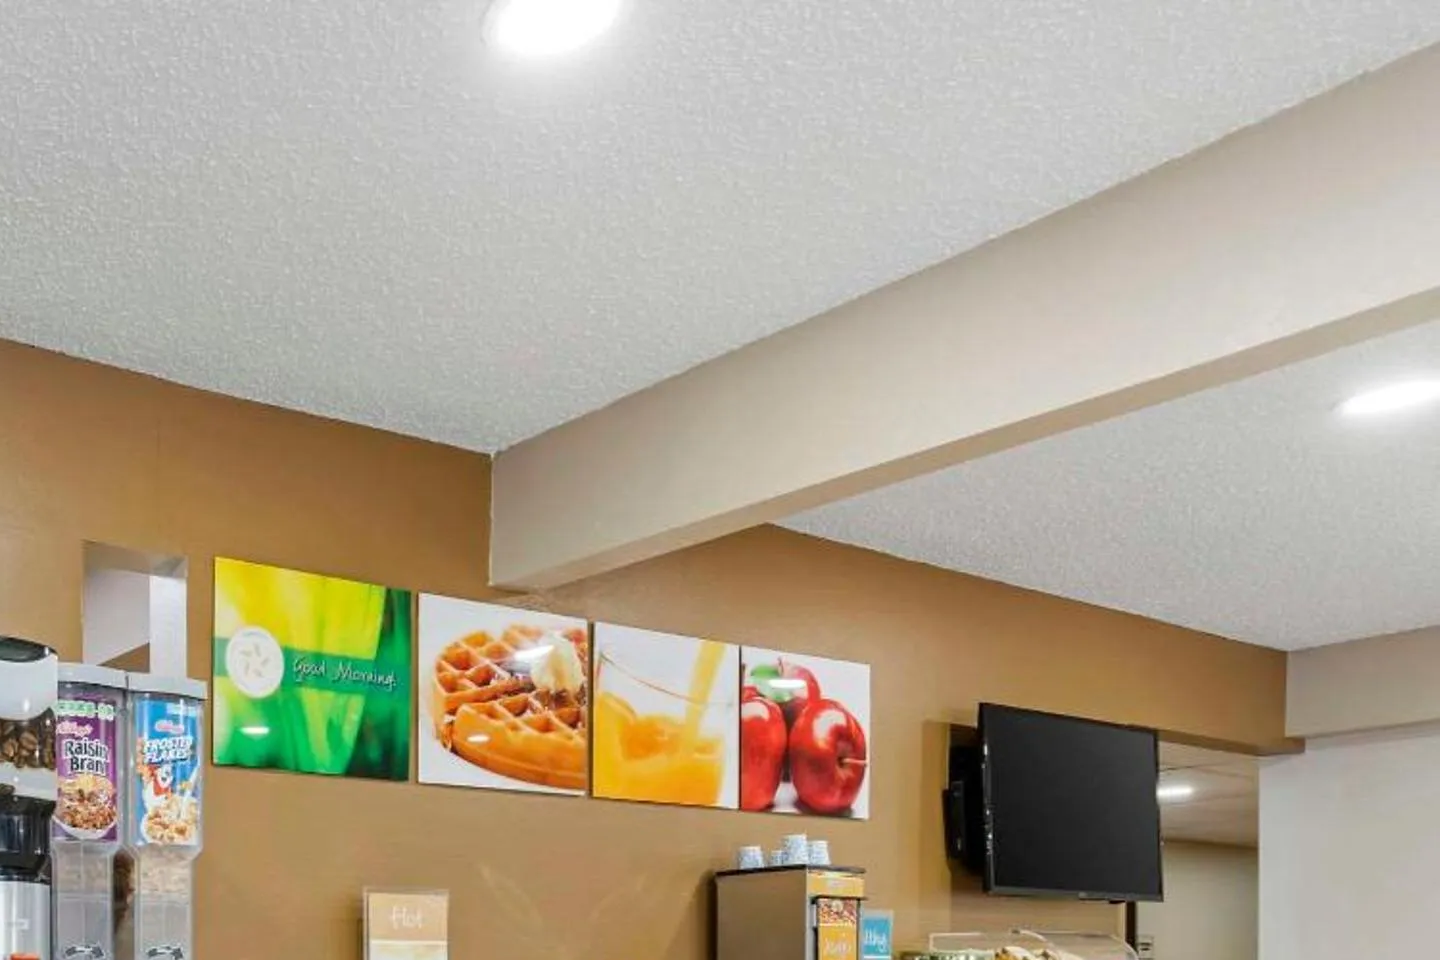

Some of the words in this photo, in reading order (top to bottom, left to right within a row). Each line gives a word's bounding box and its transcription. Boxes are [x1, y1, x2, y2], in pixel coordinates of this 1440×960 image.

[293, 657, 327, 682] Good
[64, 738, 108, 758] Raisin
[70, 756, 107, 774] Bran
